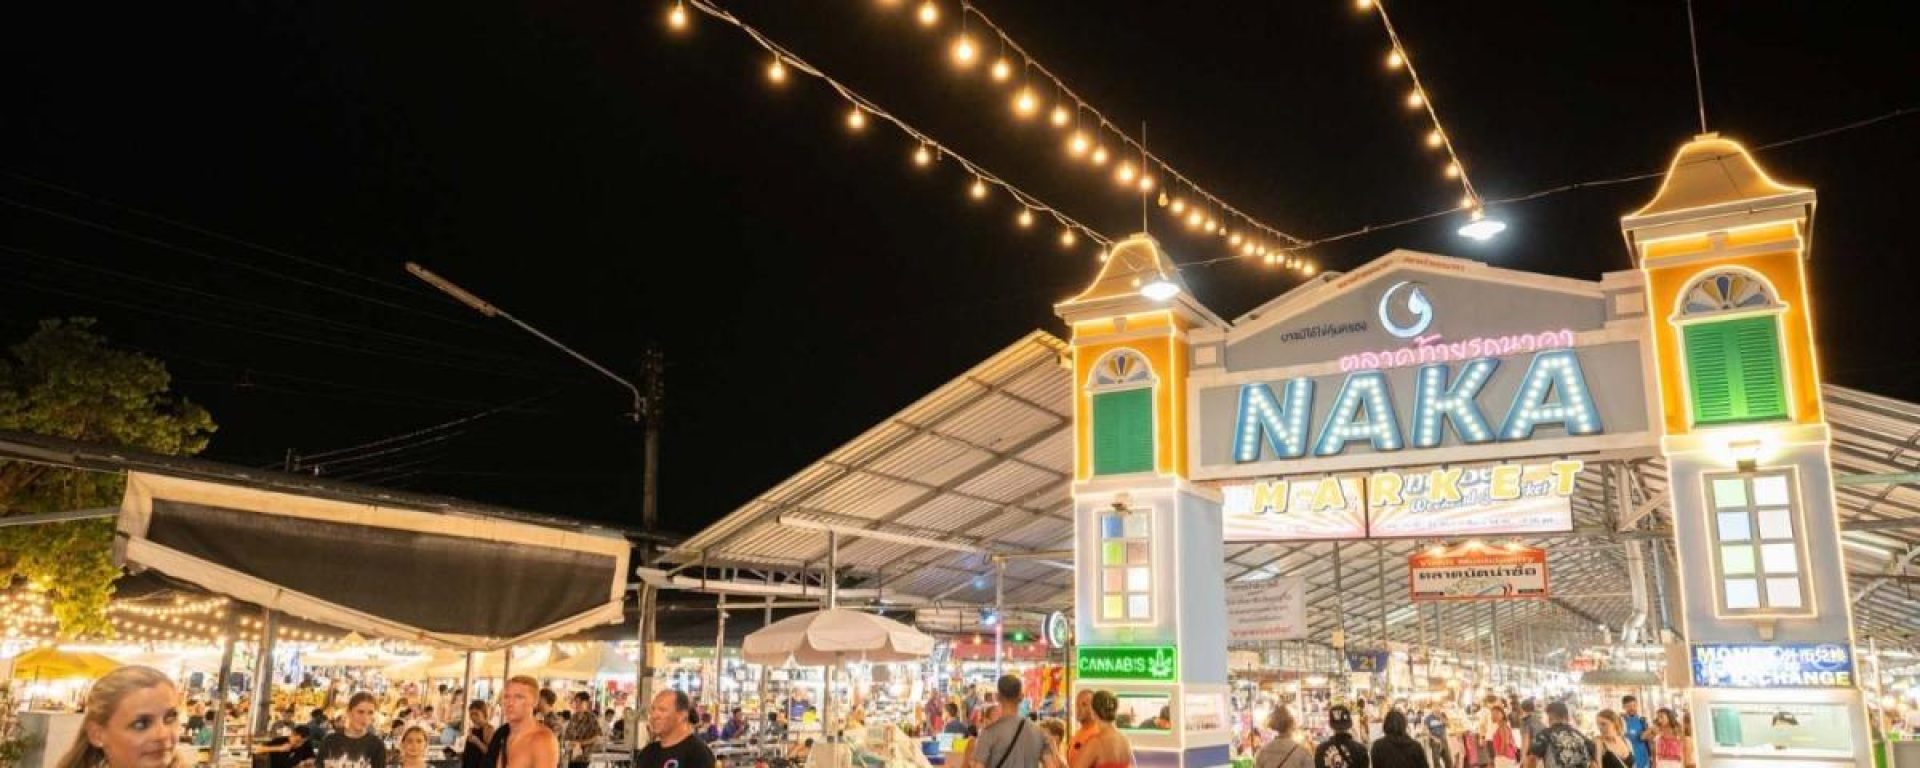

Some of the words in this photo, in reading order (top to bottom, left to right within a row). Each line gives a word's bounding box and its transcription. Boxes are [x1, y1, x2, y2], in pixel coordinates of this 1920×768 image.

[1339, 328, 1575, 372] ตลาดท้ายรถนาคา
[1232, 346, 1604, 465] NAKA
[1252, 459, 1584, 515] MARKET
[1079, 656, 1146, 673] CANNABIS
